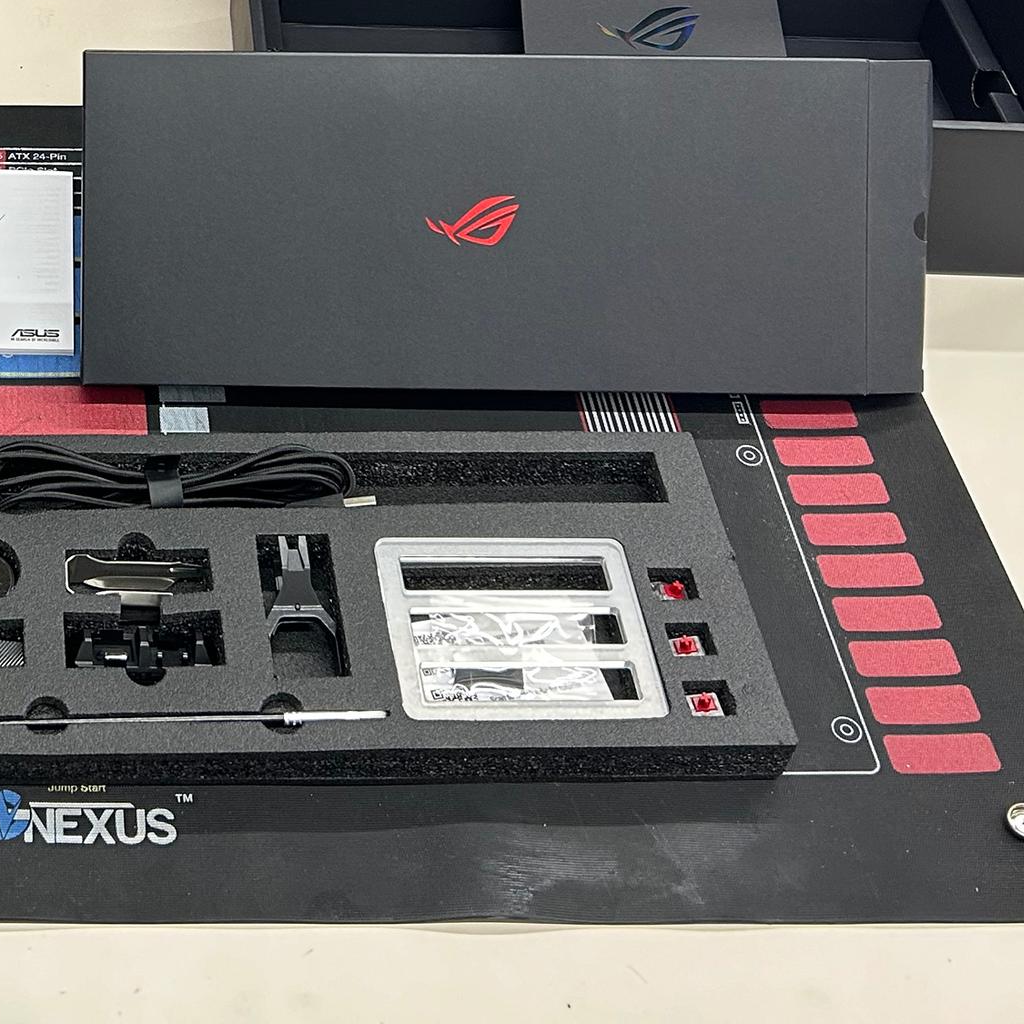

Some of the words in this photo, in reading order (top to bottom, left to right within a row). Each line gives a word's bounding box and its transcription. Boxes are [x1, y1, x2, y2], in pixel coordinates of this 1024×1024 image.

[8, 152, 31, 160] ATX
[11, 328, 60, 338] ASUS
[24, 808, 177, 845] NEXUS
[175, 793, 194, 803] TM
